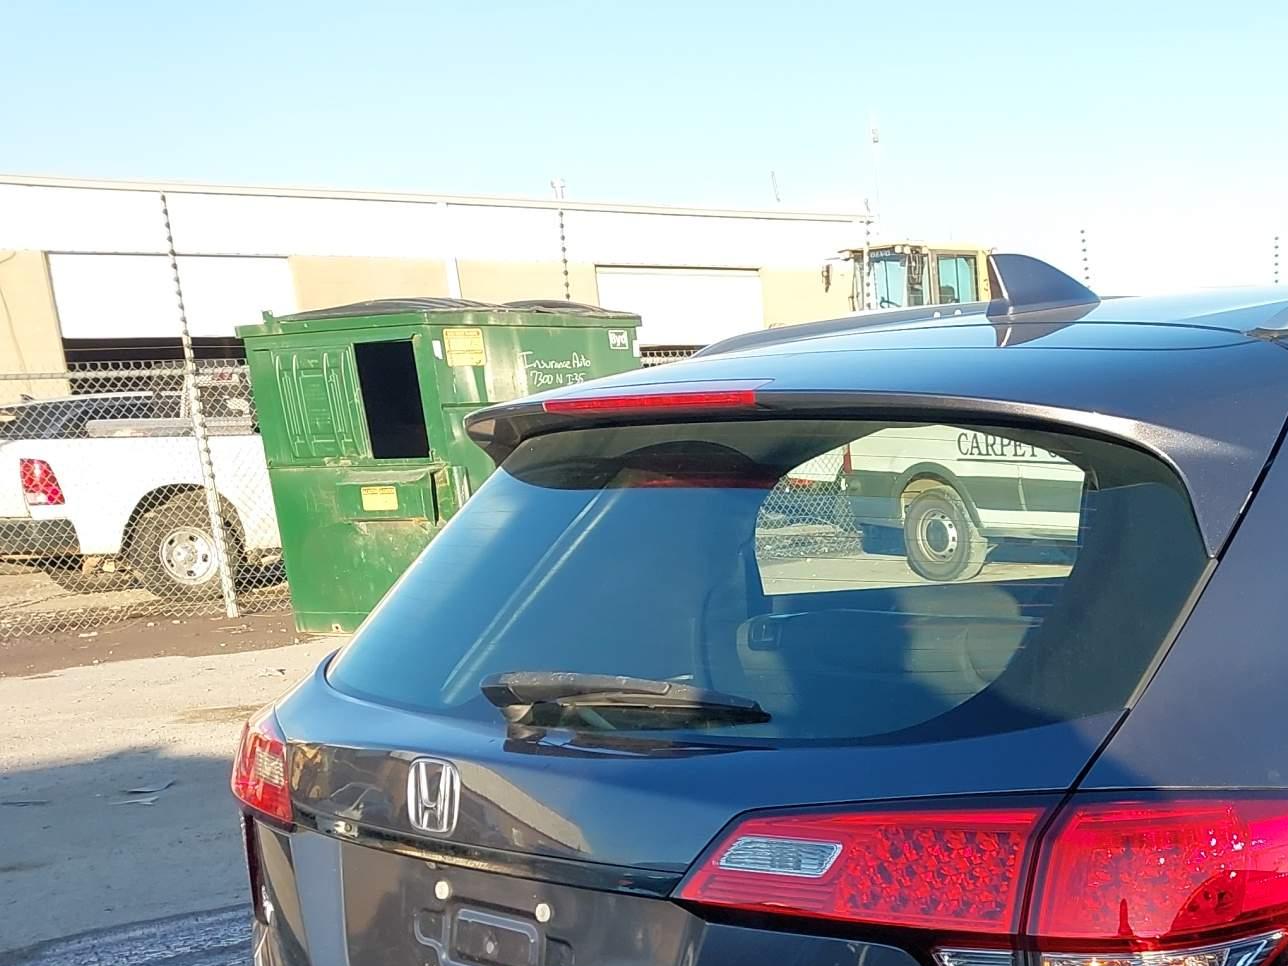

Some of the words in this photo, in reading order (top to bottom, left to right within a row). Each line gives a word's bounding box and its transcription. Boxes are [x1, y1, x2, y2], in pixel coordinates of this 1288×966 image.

[520, 351, 571, 369] Insurance
[530, 370, 553, 387] 7300
[556, 374, 563, 384] N
